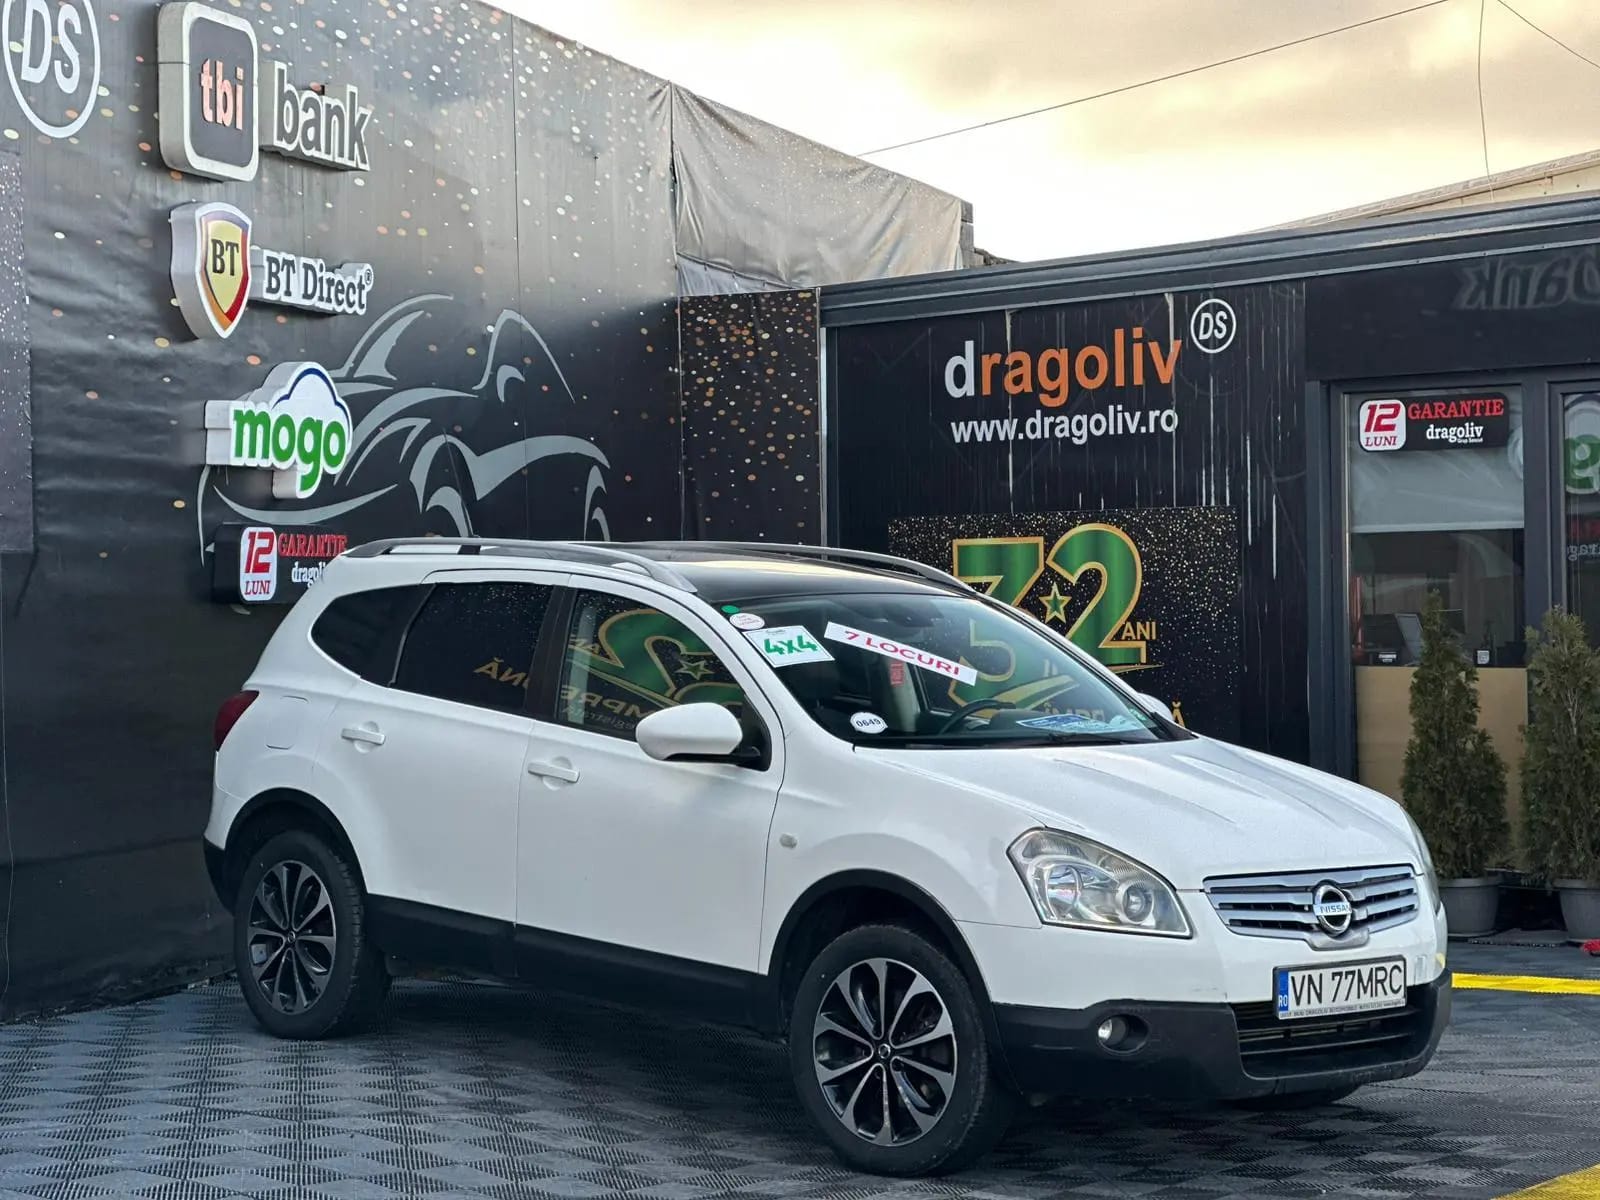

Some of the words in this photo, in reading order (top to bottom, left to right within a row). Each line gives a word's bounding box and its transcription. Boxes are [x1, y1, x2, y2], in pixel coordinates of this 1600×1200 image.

[21, 0, 82, 94] DS
[200, 58, 244, 130] tbi
[273, 64, 371, 168] bank
[211, 238, 240, 276] BT
[265, 254, 296, 298] BT
[1199, 310, 1228, 340] DS
[944, 326, 1183, 408] dragoliv
[1364, 403, 1402, 433] 12
[1407, 398, 1505, 420] GARANTIE
[950, 404, 1179, 446] www.dragoliv.ro
[1425, 421, 1484, 443] dragoliv
[233, 408, 346, 492] mogo
[1364, 435, 1398, 447] LUNI
[244, 531, 276, 574] 12
[277, 531, 349, 558] GARANTIE
[244, 579, 272, 596] LUNI
[763, 634, 818, 657] 4x4
[1121, 621, 1158, 641] ANI
[844, 629, 860, 641] 7
[865, 636, 960, 676] LOCURI
[855, 717, 882, 728] 0649
[1290, 972, 1324, 1007] VN
[1331, 964, 1403, 1003] 77MRC
[1278, 994, 1289, 1008] RO
